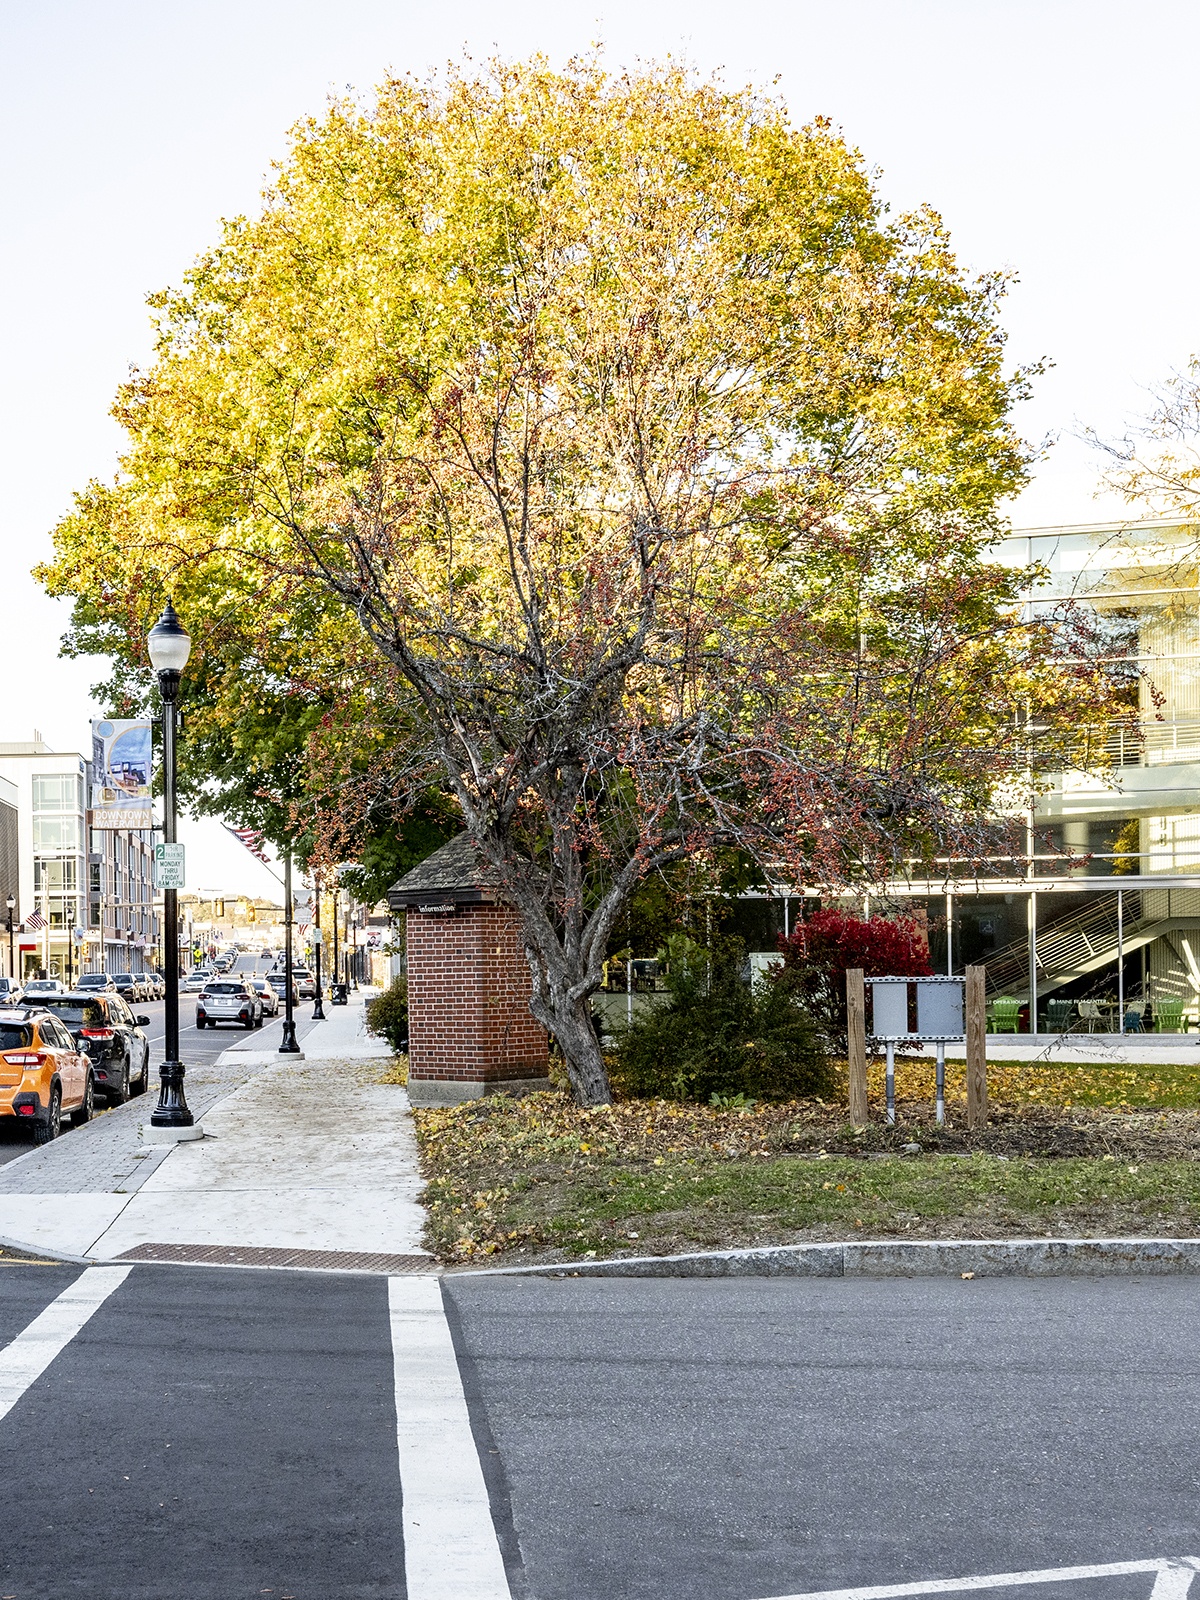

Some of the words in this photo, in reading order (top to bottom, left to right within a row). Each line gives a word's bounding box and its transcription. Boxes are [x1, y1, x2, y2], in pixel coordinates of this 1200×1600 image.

[95, 811, 149, 820] DOWNTOWN
[95, 820, 149, 829] WATERVILLE
[157, 847, 164, 858] 2
